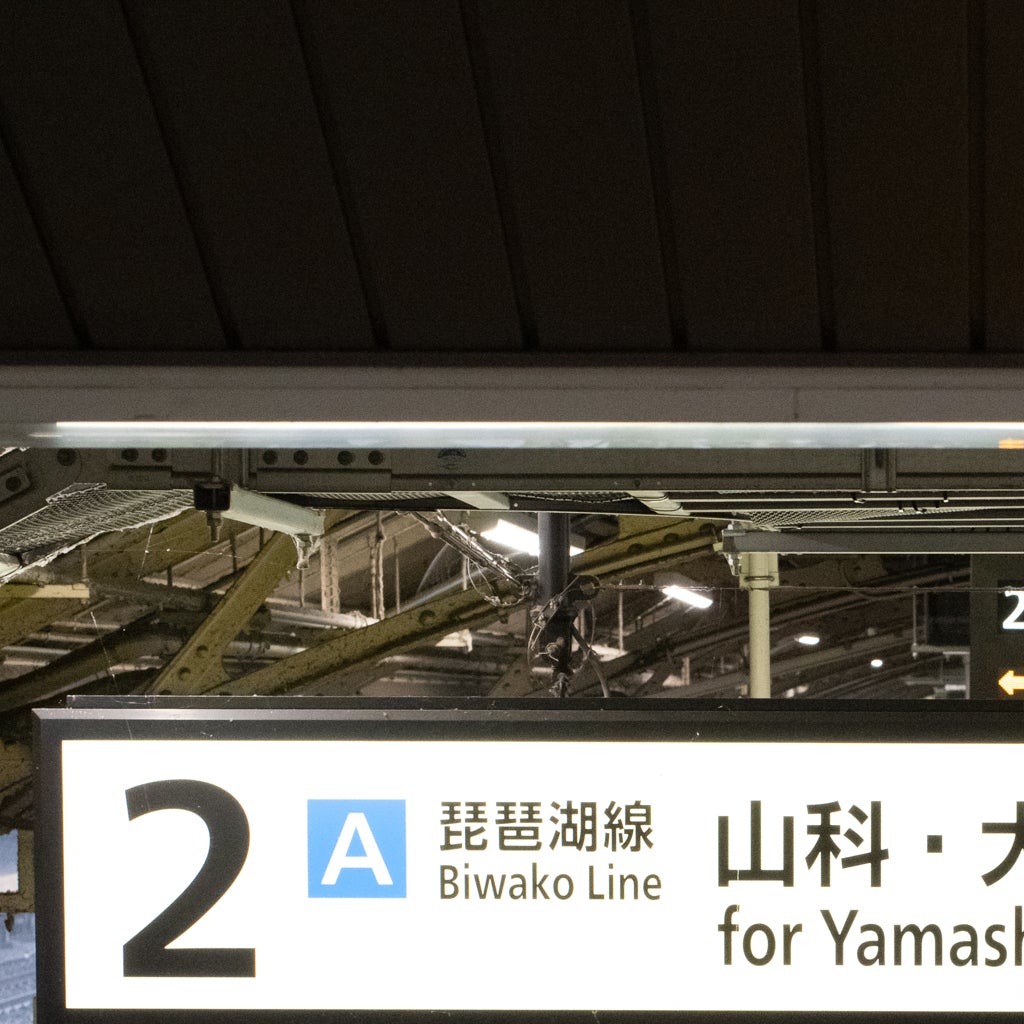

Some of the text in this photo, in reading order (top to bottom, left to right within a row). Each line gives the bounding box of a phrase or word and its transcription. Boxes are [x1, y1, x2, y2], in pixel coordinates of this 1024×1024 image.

[320, 812, 394, 886] A
[441, 801, 654, 852] 琵琶湖線
[122, 779, 256, 978] 2
[440, 864, 662, 900] Biwako Line
[718, 904, 803, 966] for
